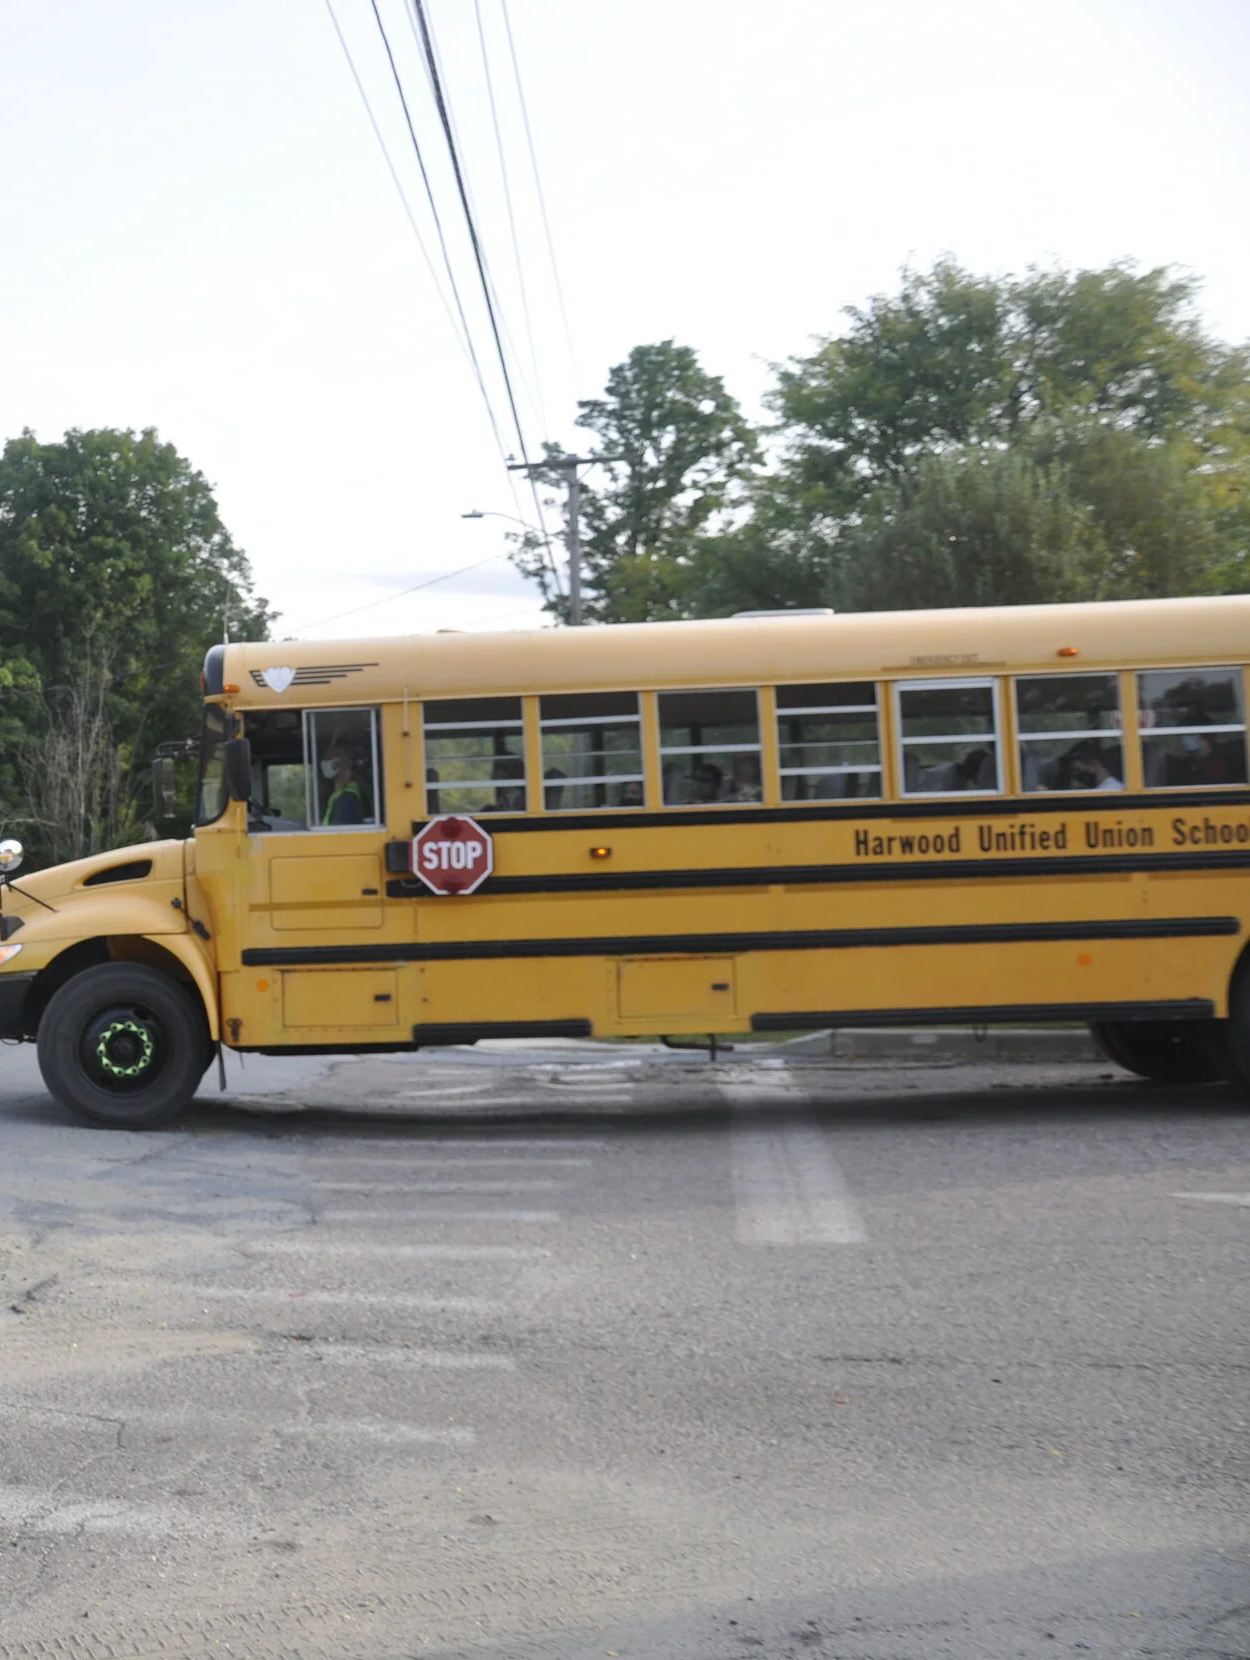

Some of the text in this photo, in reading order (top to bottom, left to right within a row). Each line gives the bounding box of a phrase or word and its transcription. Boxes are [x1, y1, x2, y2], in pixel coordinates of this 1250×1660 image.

[855, 817, 1250, 856] Harwood Unified Union Schoo
[422, 840, 483, 870] STOP
